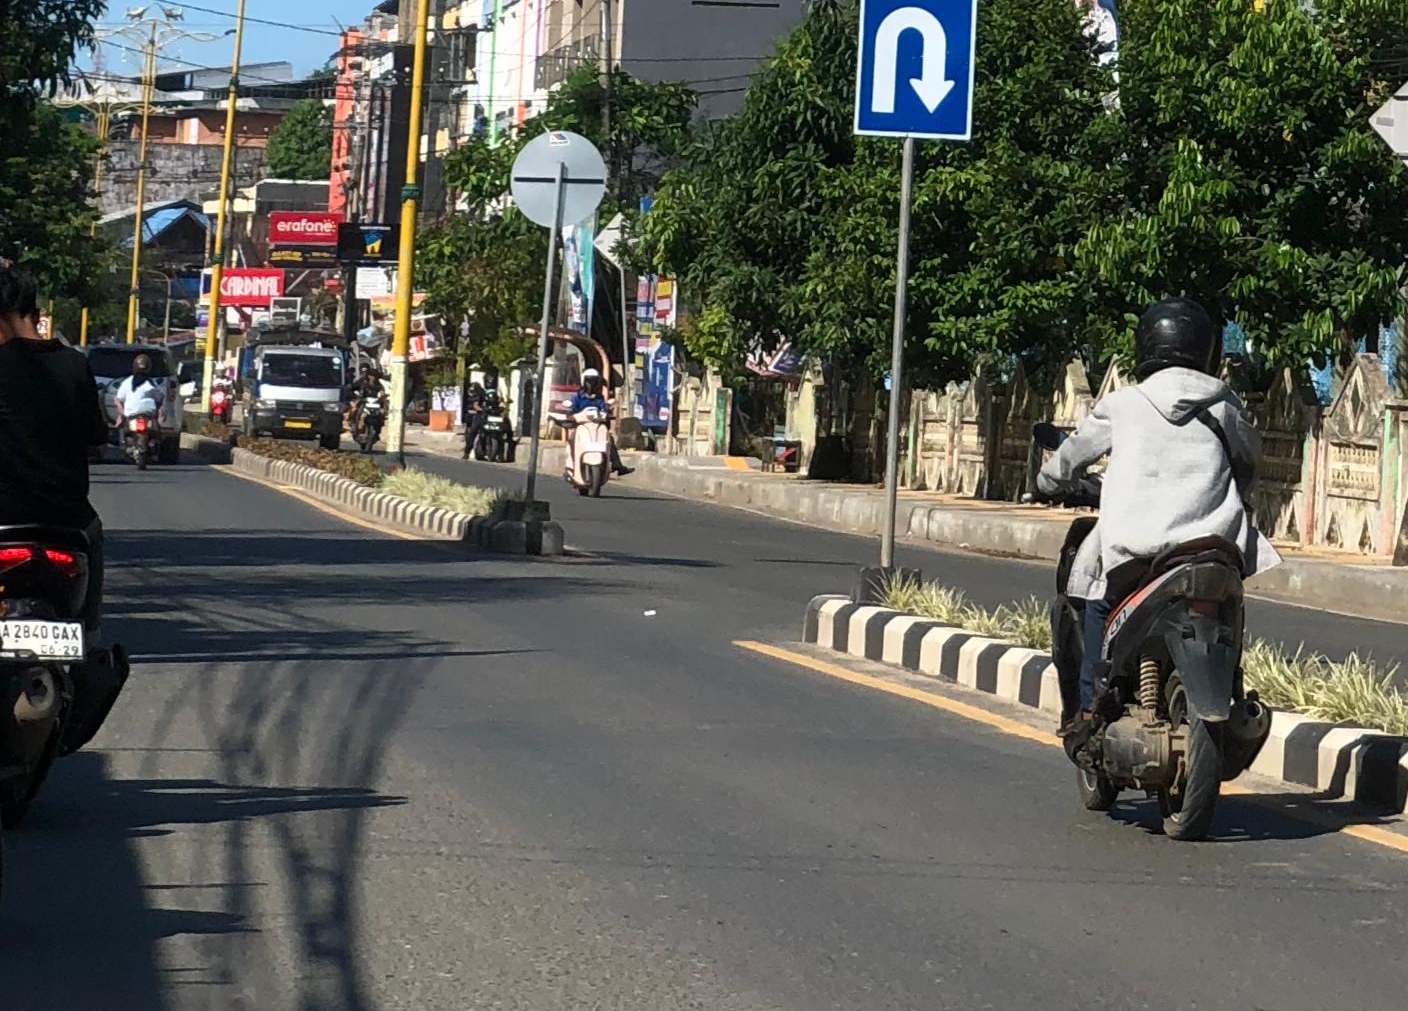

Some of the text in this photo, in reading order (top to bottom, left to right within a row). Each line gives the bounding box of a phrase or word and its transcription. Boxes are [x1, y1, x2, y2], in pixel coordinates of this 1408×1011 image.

[277, 218, 333, 232] erafone
[220, 276, 281, 296] CARDINAL
[14, 624, 48, 639] 2840
[52, 625, 79, 641] GAX
